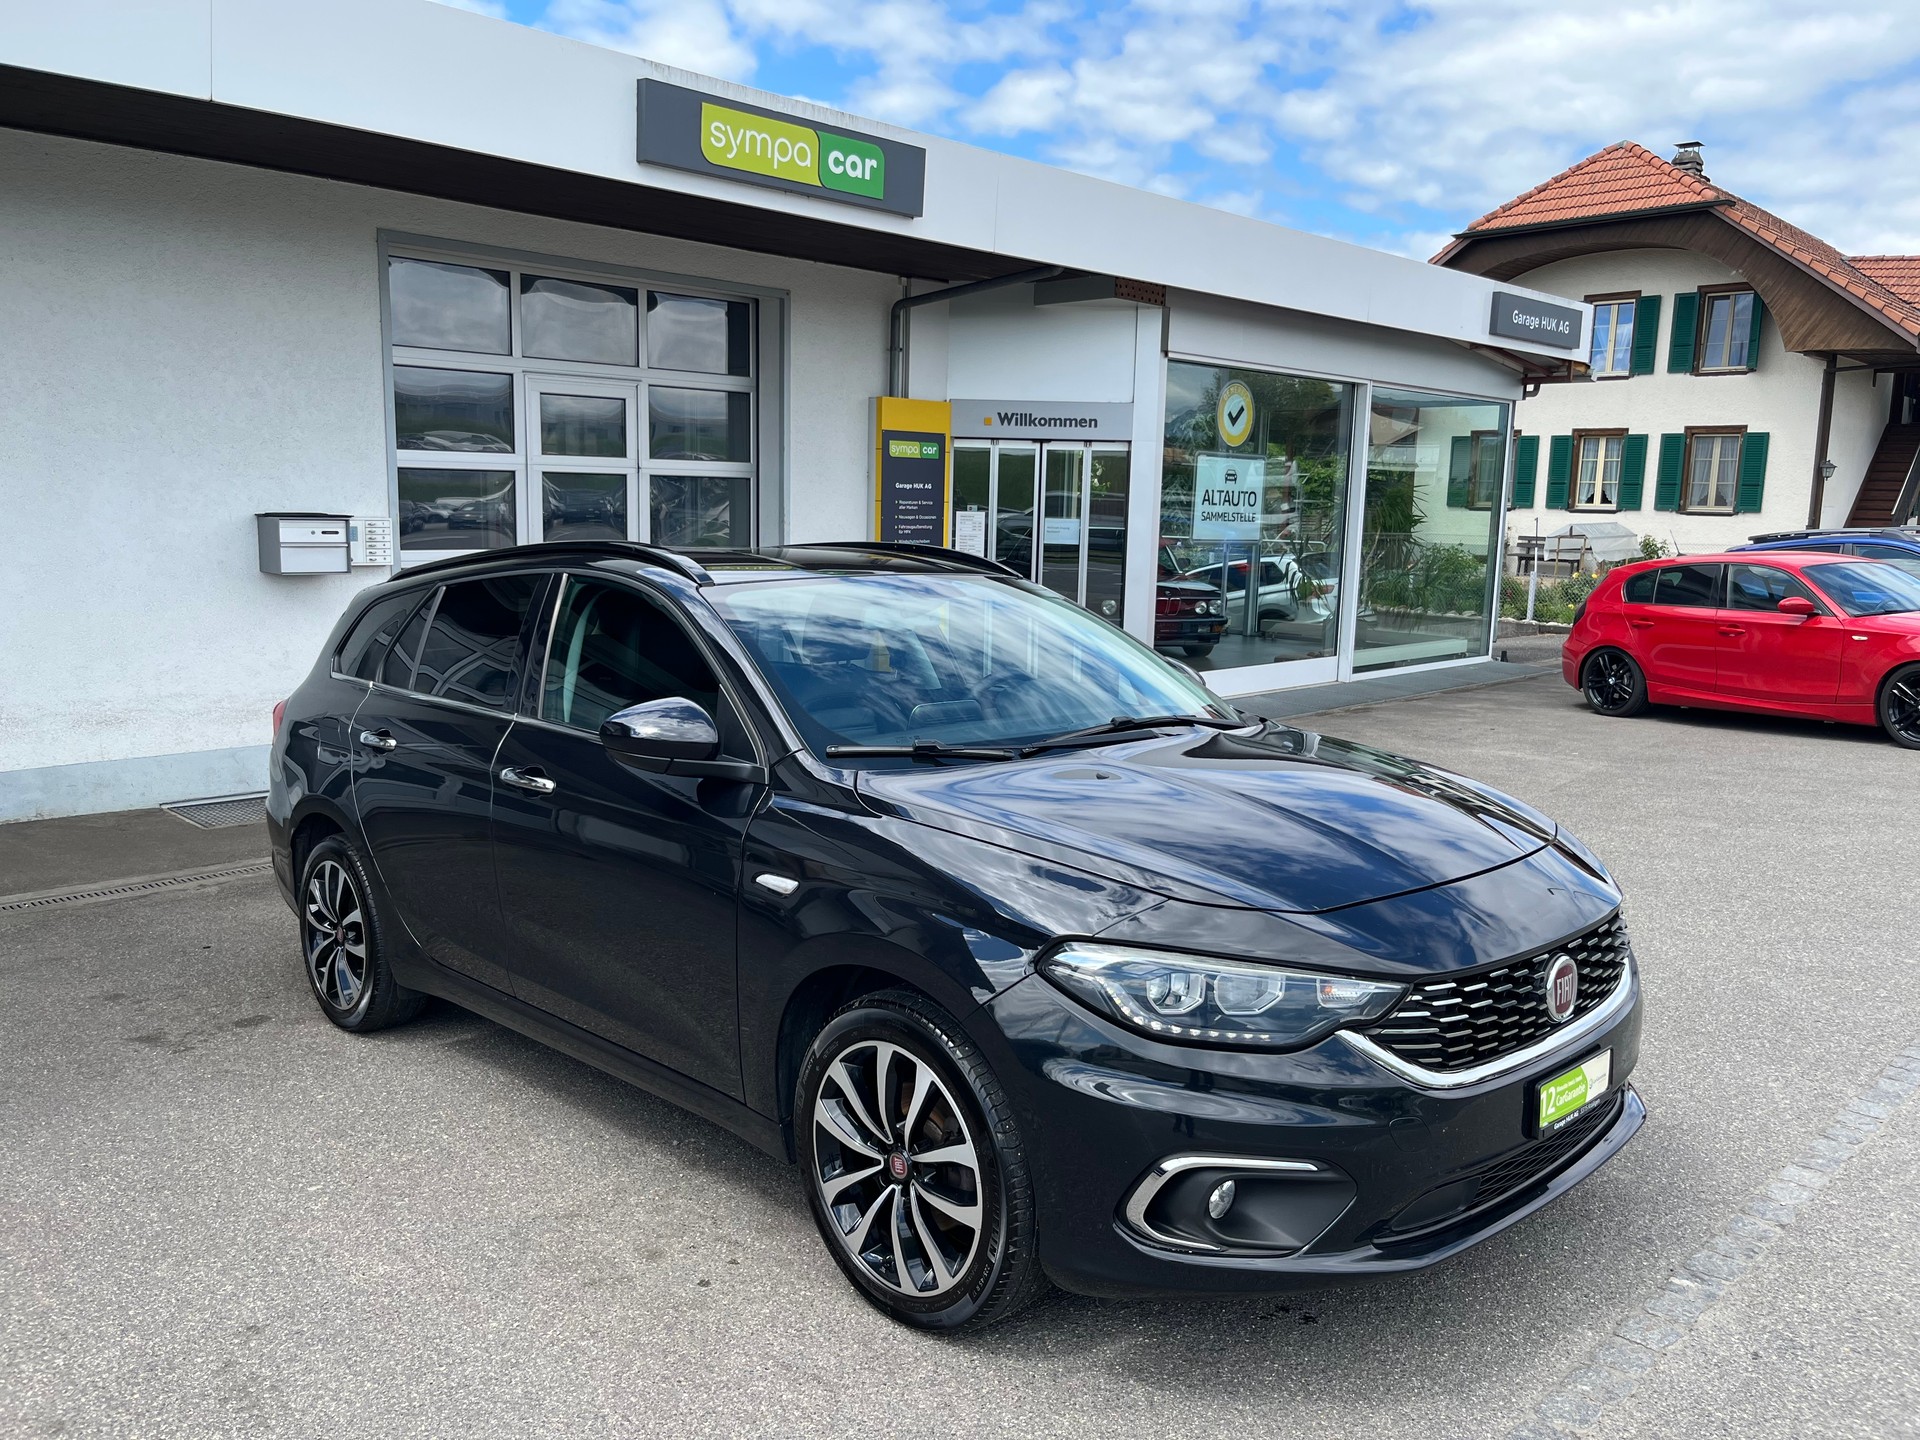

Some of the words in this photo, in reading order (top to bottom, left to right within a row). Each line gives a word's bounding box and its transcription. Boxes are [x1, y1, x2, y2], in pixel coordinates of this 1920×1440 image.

[709, 120, 812, 170] sympa
[827, 150, 878, 181] car
[1512, 309, 1540, 330] Garage
[1541, 316, 1558, 332] HUK
[1558, 321, 1570, 334] AG
[997, 412, 1098, 429] Willkommen
[891, 444, 919, 456] sympa
[922, 446, 937, 455] car
[895, 482, 912, 490] Garage
[1201, 490, 1257, 507] ALTAUTO
[1201, 511, 1256, 523] SAMMELSTELLE
[1556, 972, 1573, 1006] FIAT
[1540, 1086, 1557, 1118] 12
[894, 1157, 904, 1174] FIAT
